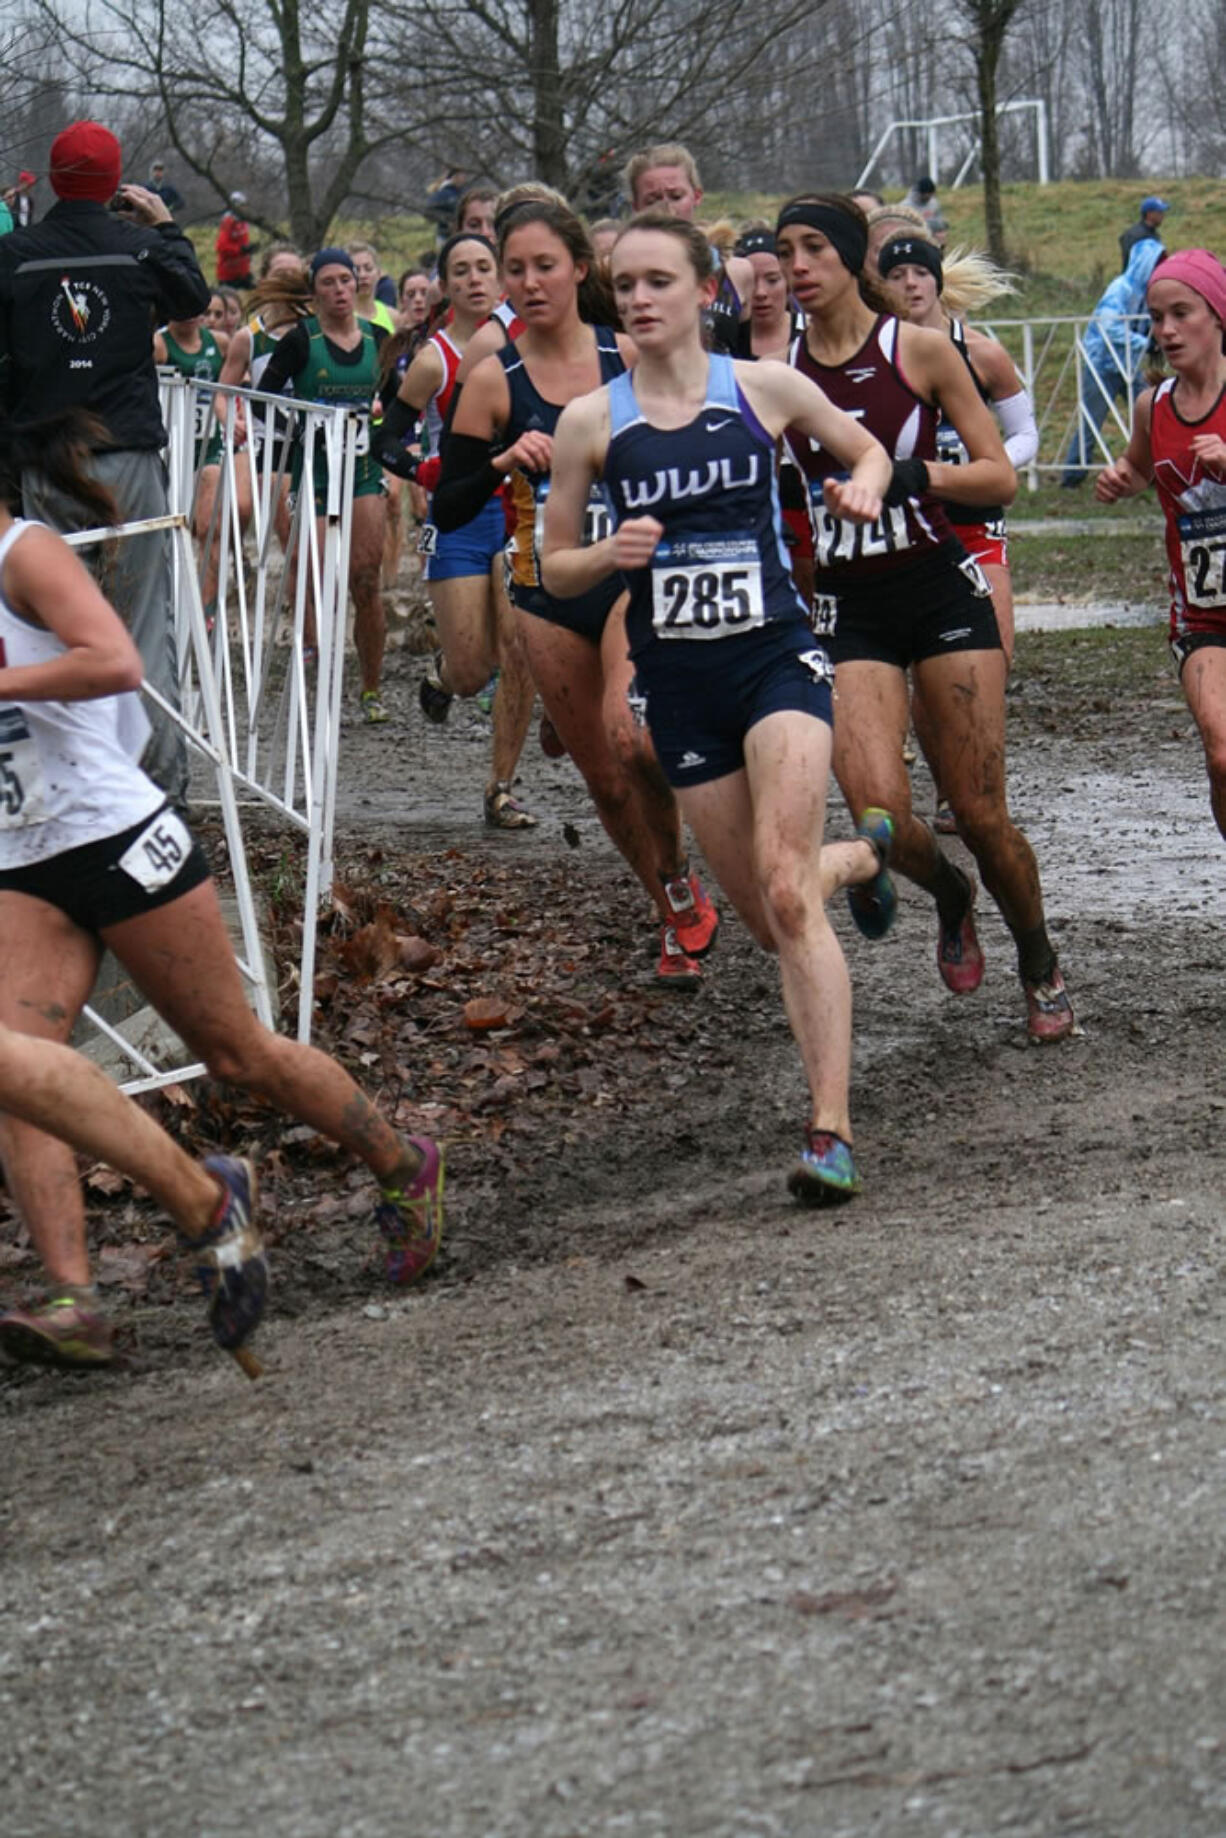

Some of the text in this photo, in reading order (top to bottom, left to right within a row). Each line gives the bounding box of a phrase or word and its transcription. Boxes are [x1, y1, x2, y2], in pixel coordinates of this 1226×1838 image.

[69, 359, 94, 369] 2014
[620, 454, 758, 509] WWU
[663, 570, 751, 629] 285
[142, 824, 182, 872] 45
